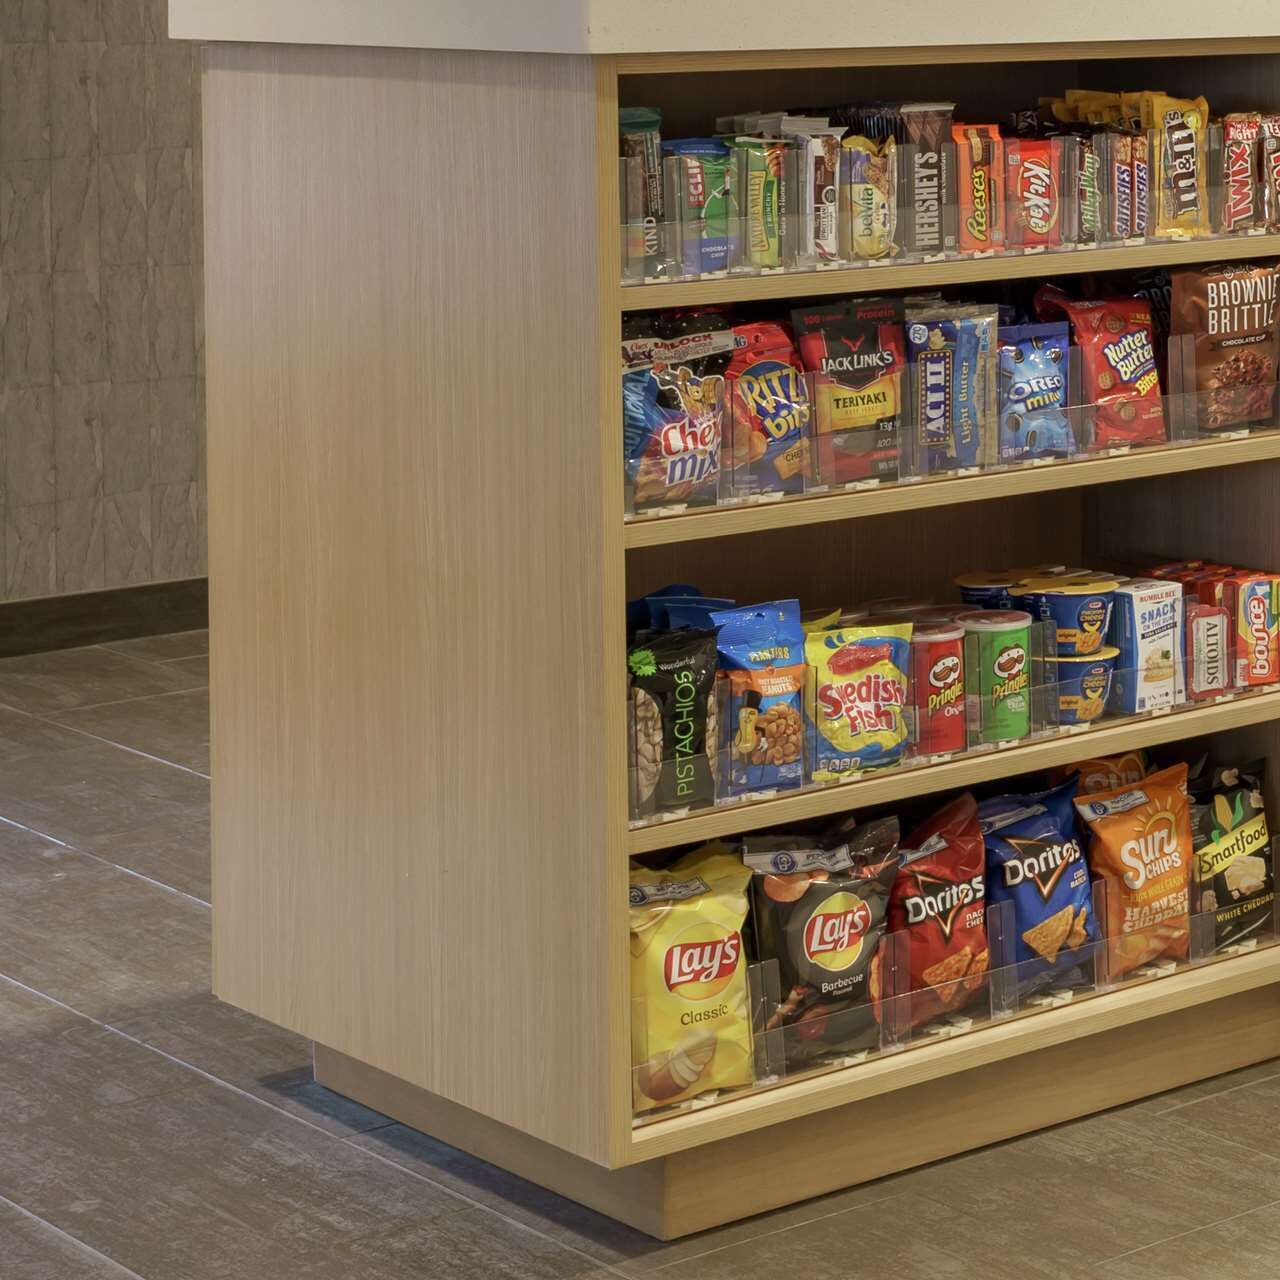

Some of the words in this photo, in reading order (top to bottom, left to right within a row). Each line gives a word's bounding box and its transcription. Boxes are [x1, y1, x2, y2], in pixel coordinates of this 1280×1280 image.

[858, 187, 874, 237] belVita
[915, 151, 940, 246] HERSHEY'S
[967, 165, 988, 241] Reese's
[1116, 165, 1131, 236] SATISFIES
[644, 217, 658, 256] KIND
[1208, 274, 1279, 308] BROWNIE
[912, 326, 922, 341] 270
[1208, 300, 1276, 335] BRITTLE
[821, 356, 853, 374] JACK
[853, 351, 893, 369] LINK'S
[1104, 329, 1148, 366] Nutter
[1116, 344, 1154, 381] Butter
[737, 367, 803, 415] RITZ
[833, 392, 887, 409] TERIYAKI
[959, 361, 970, 402] Butter
[1008, 376, 1062, 401] OREO
[960, 407, 972, 444] Light
[1141, 601, 1176, 625] SNACK
[1206, 621, 1219, 685] ALTOIDS
[818, 673, 906, 718] Swedish
[674, 671, 695, 796] PISTACHIOS
[844, 702, 896, 734] Fish
[1003, 838, 1081, 886] Doritos
[1120, 828, 1177, 890] Sun
[1145, 851, 1183, 879] CHIPS
[1200, 820, 1266, 874] Smartfood
[905, 875, 985, 924] Doritos
[1215, 907, 1241, 923] WHITE
[1243, 892, 1275, 913] CHEDDAR
[810, 906, 866, 953] Lay's
[669, 935, 738, 985] Lay's
[820, 973, 864, 993] Barbecue
[680, 1003, 729, 1026] Classic
